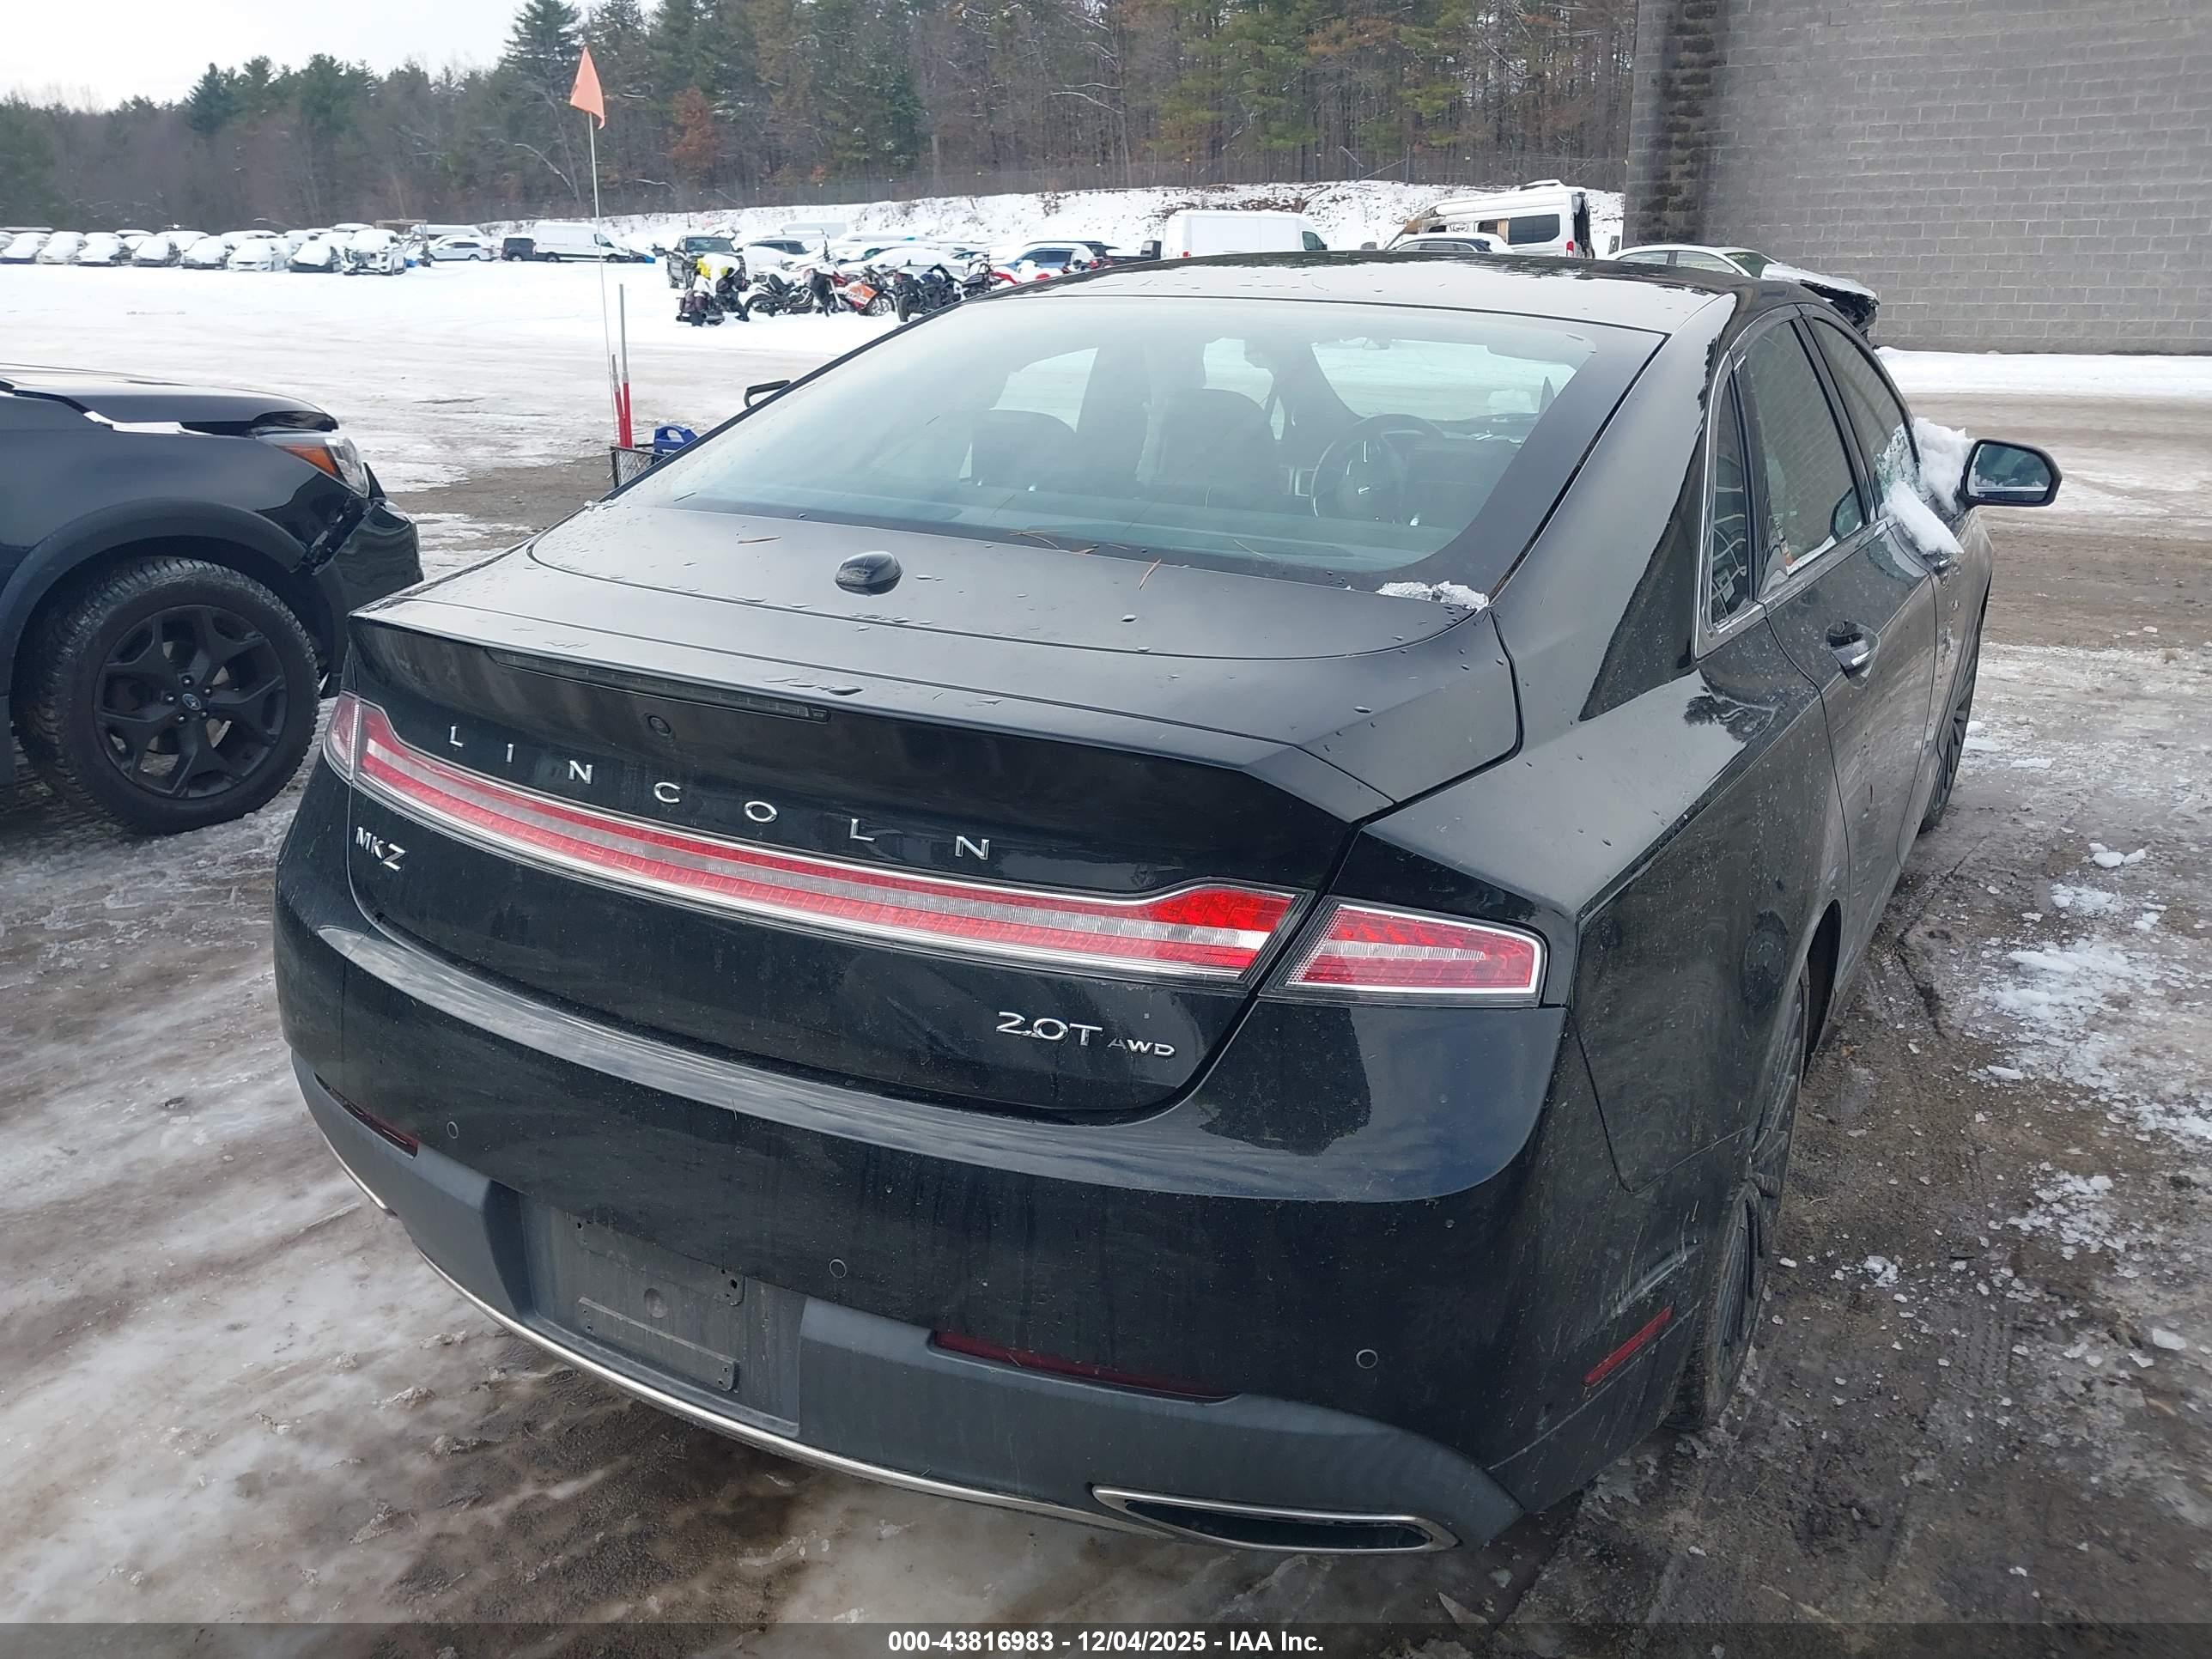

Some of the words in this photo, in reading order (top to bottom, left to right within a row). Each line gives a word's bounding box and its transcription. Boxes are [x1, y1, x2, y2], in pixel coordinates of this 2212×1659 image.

[449, 725, 990, 860] LINCOLN
[356, 826, 407, 872] MKZ
[1108, 1037, 1176, 1057] AWD
